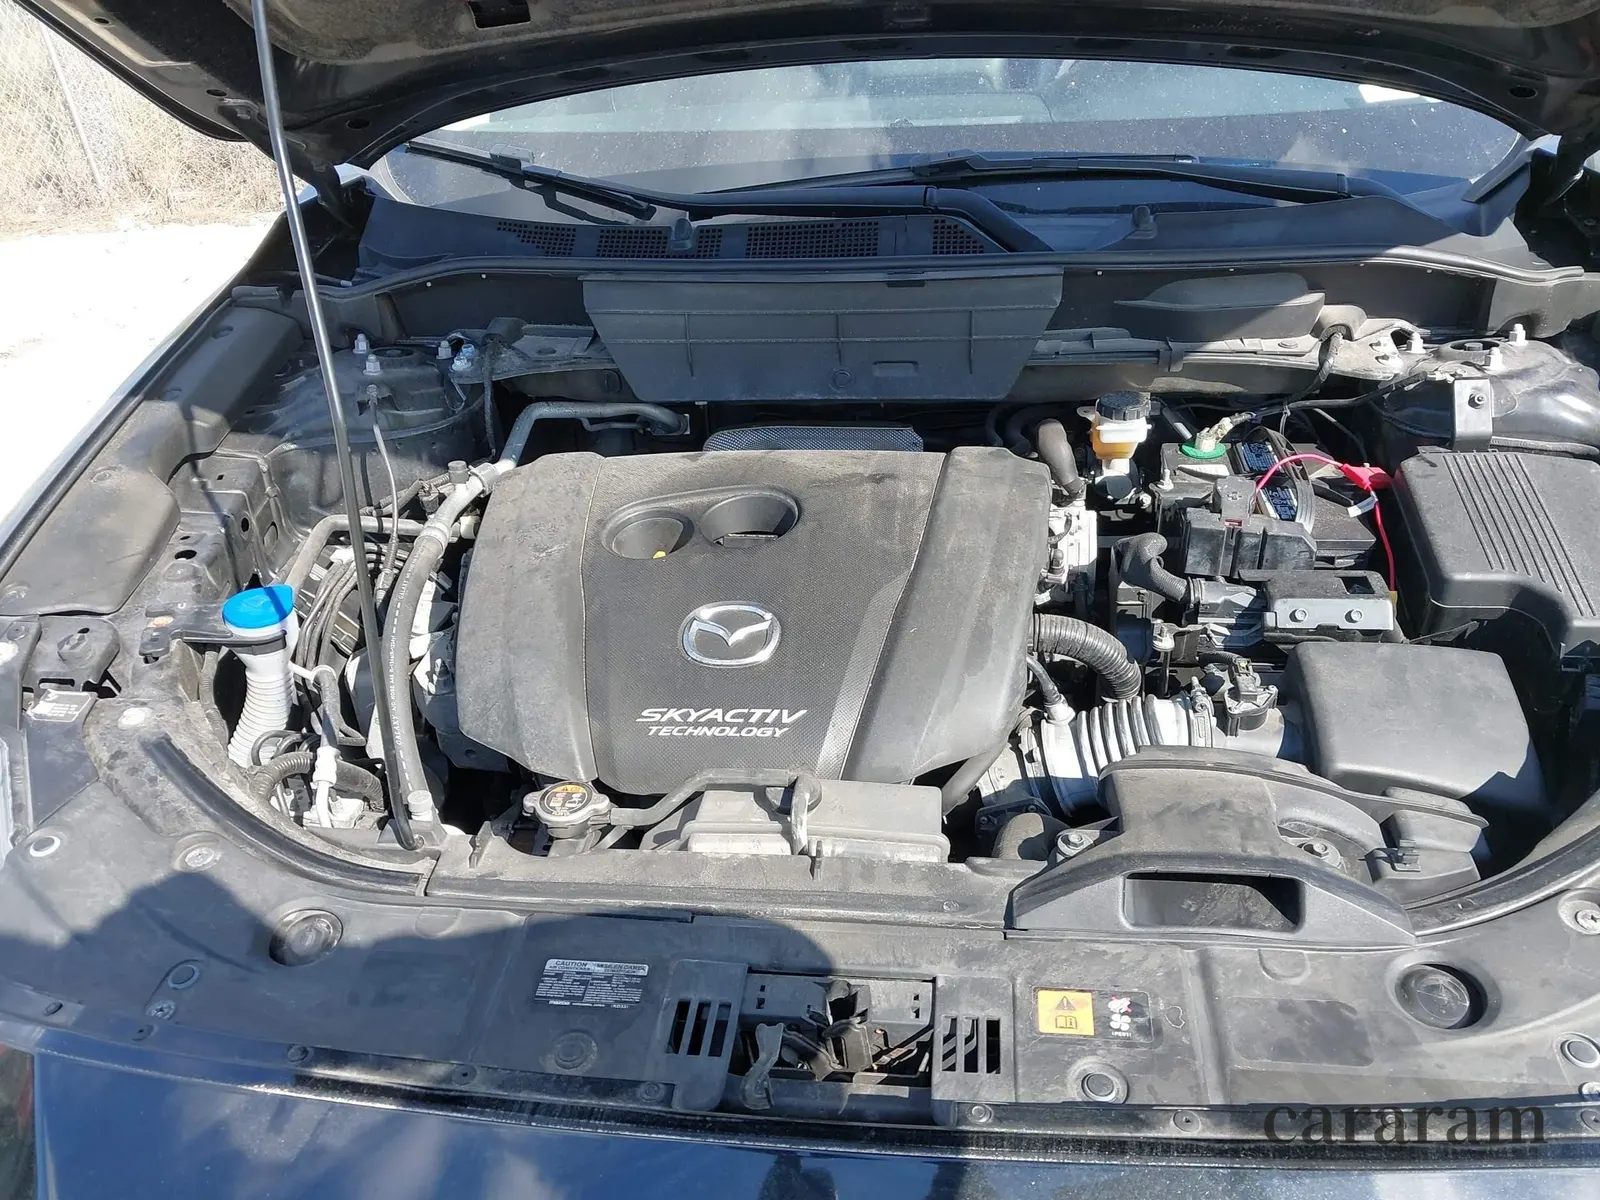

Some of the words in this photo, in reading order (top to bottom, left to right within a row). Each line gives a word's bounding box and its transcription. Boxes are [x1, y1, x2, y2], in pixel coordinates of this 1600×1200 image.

[635, 708, 808, 724] SKYACTIV
[391, 714, 401, 746] GALAXY
[648, 726, 790, 738] TECHNOLOGY
[555, 960, 588, 968] CAUTION
